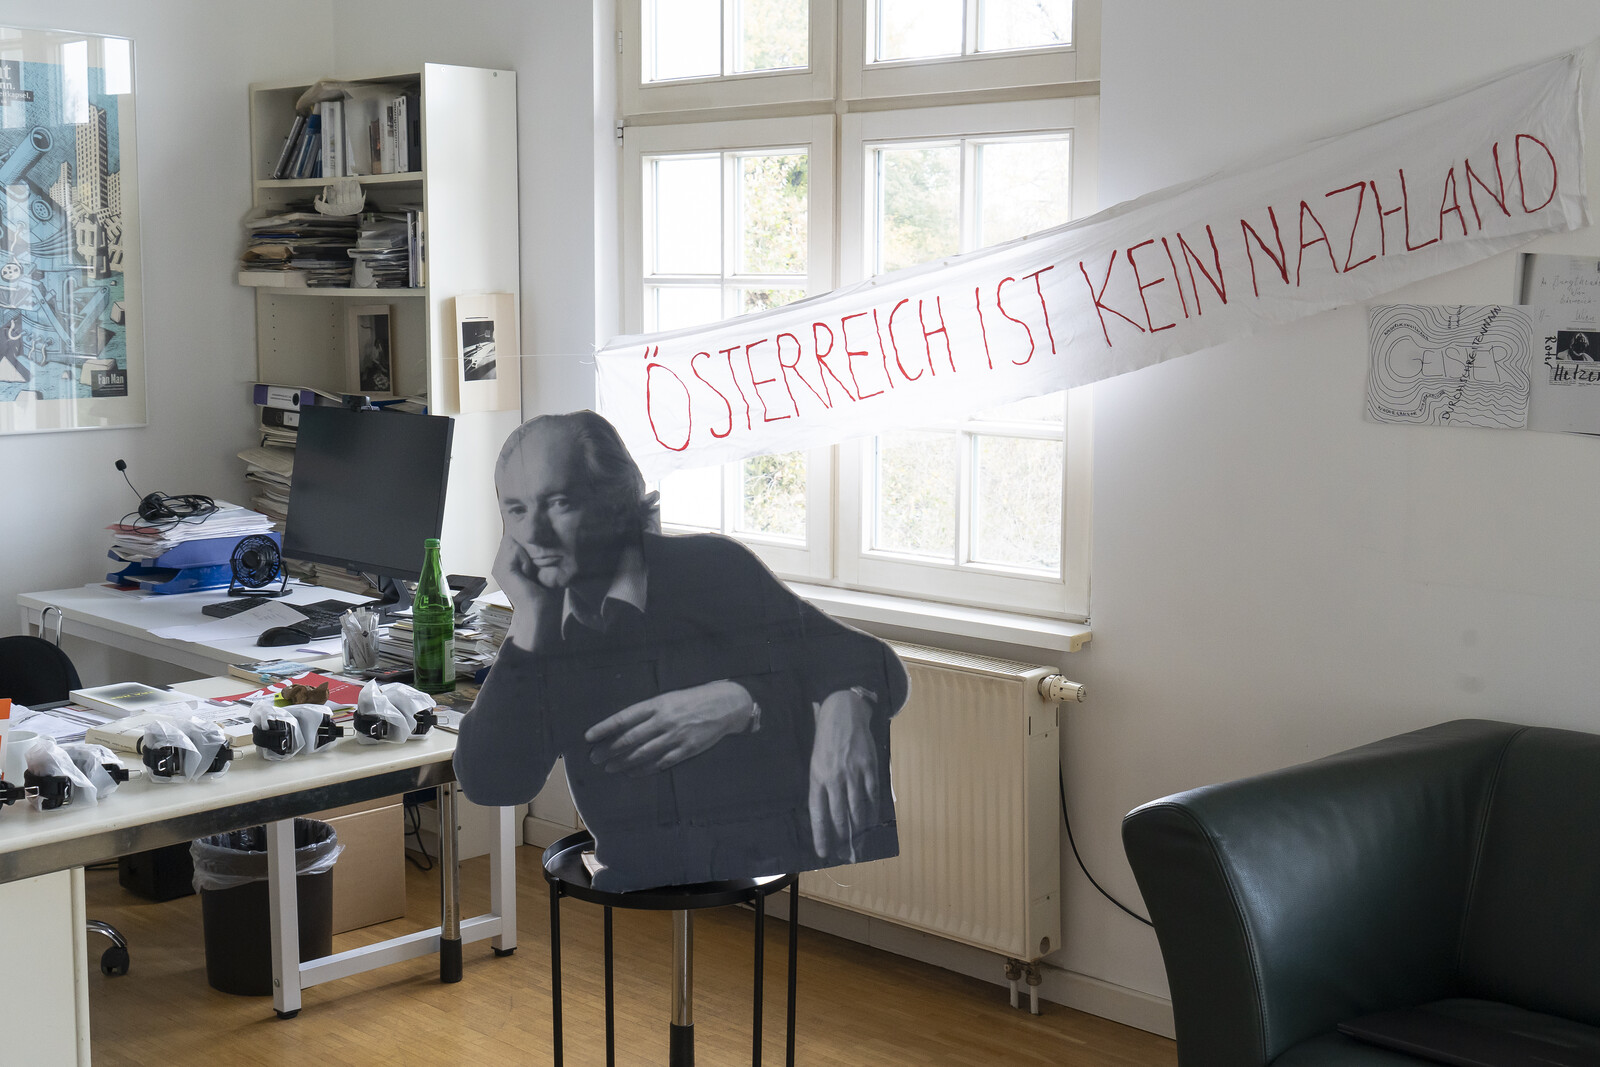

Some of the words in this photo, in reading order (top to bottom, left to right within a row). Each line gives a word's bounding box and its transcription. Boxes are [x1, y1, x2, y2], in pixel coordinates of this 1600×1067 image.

[97, 373, 110, 385] Fan
[110, 373, 124, 384] Man
[644, 295, 956, 451] ÖSTERREICH
[974, 265, 1056, 370] IST
[1079, 224, 1228, 348] KEIN
